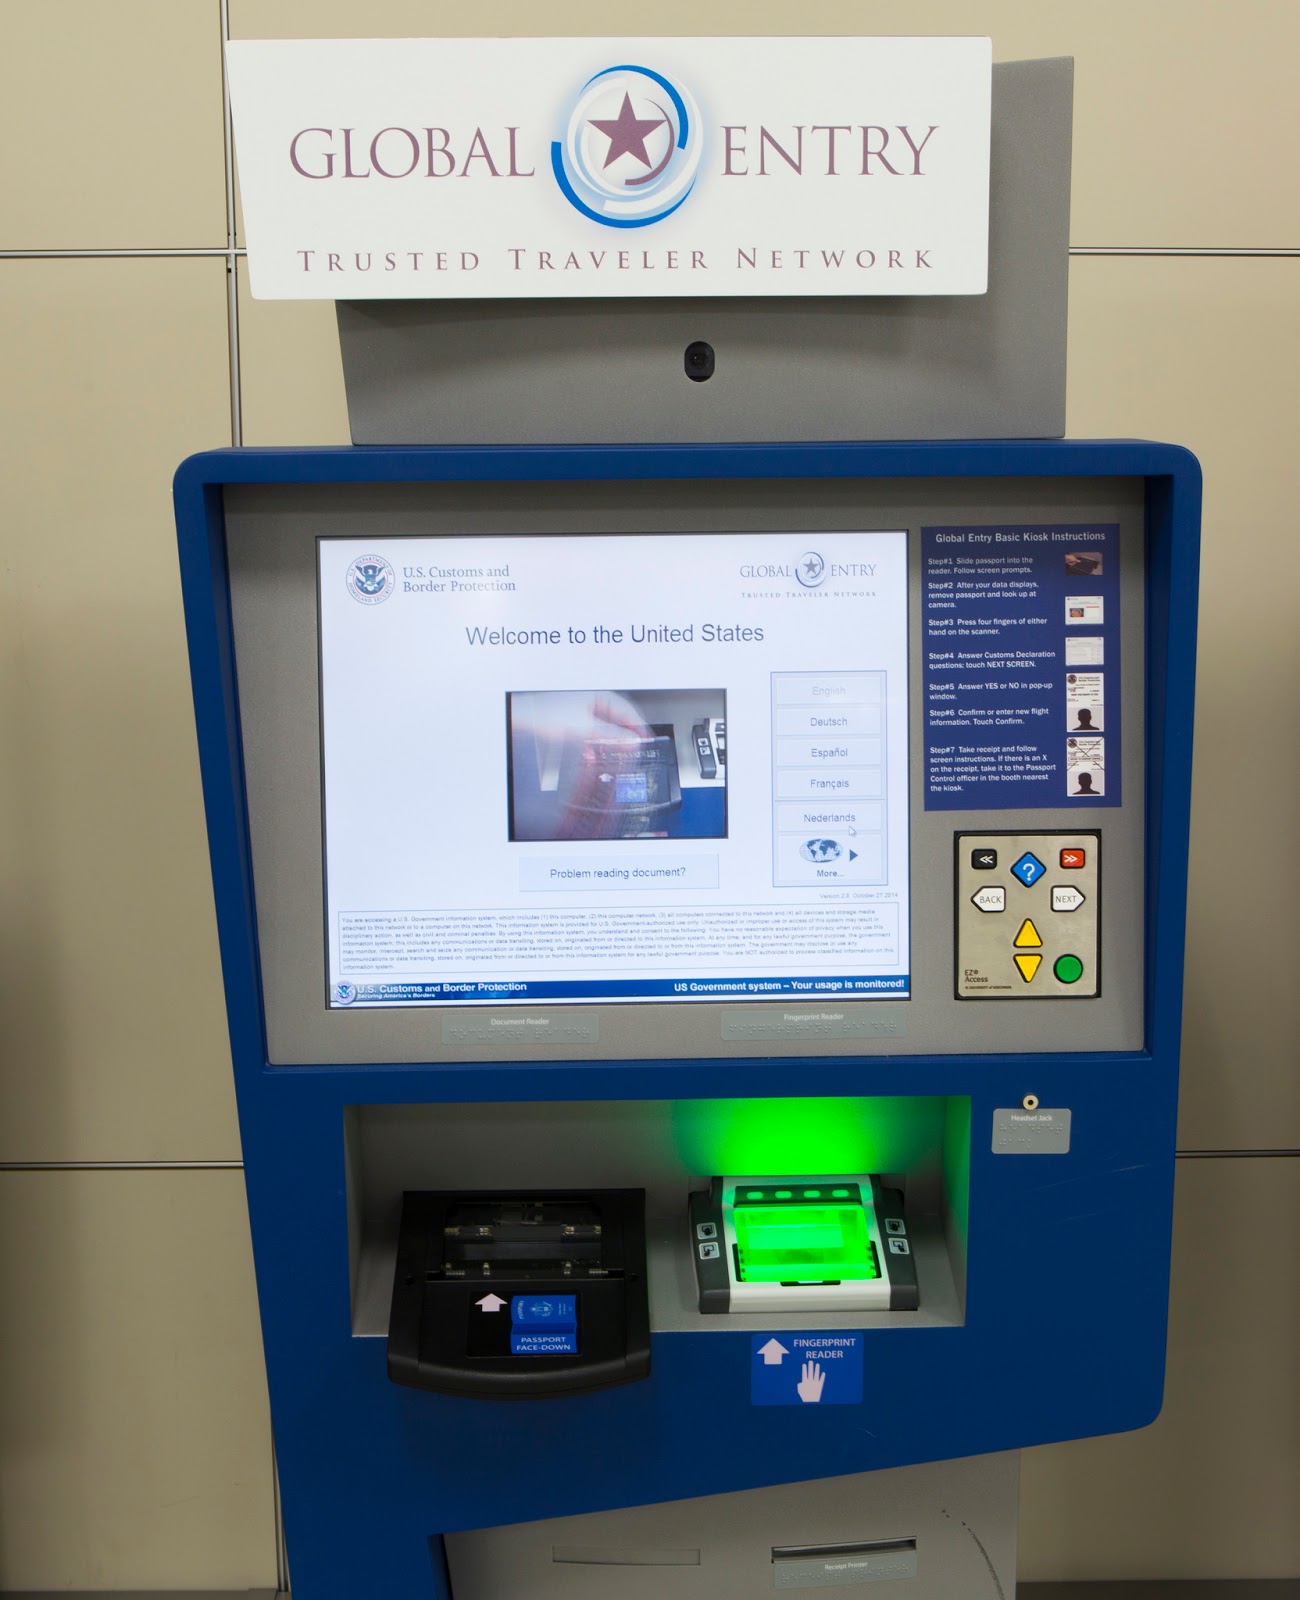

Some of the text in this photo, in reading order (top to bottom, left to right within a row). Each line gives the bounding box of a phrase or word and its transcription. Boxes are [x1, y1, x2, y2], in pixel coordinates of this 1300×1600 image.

[290, 126, 939, 179] GLOBAL ENTRY
[297, 248, 934, 272] TRUSTED TRAVELER NETWORK
[936, 532, 1105, 544] Global Entry Basic Kiosk Instructions
[928, 558, 953, 566] Step#1
[976, 557, 1005, 566] passport
[403, 566, 510, 578] U.S. Customs and
[740, 564, 877, 577] GLOBAL ENTRY
[1002, 566, 1032, 575] prompts.
[403, 581, 516, 592] Border Protection
[928, 582, 953, 591] Step#2
[956, 591, 986, 600] passport
[929, 619, 954, 628] Step#3
[994, 618, 1017, 627] fingers
[466, 623, 764, 644] Welcome to the United States
[929, 652, 954, 661] Step#4
[812, 686, 846, 696] English
[930, 683, 954, 692] Step#5
[930, 709, 955, 718] Step#6
[1031, 708, 1048, 717] flight
[810, 718, 847, 726] Deutsch
[811, 748, 848, 758] Español
[930, 746, 955, 755] Step#7
[977, 746, 1000, 754] receipt
[1026, 764, 1056, 773] Passport
[810, 779, 849, 789] Français
[804, 814, 856, 822] Nederlands
[550, 868, 686, 878] Problem reading document?
[1022, 863, 1035, 881] ?
[357, 983, 526, 993] U.S. Customs and Border Protection
[748, 982, 781, 991] system
